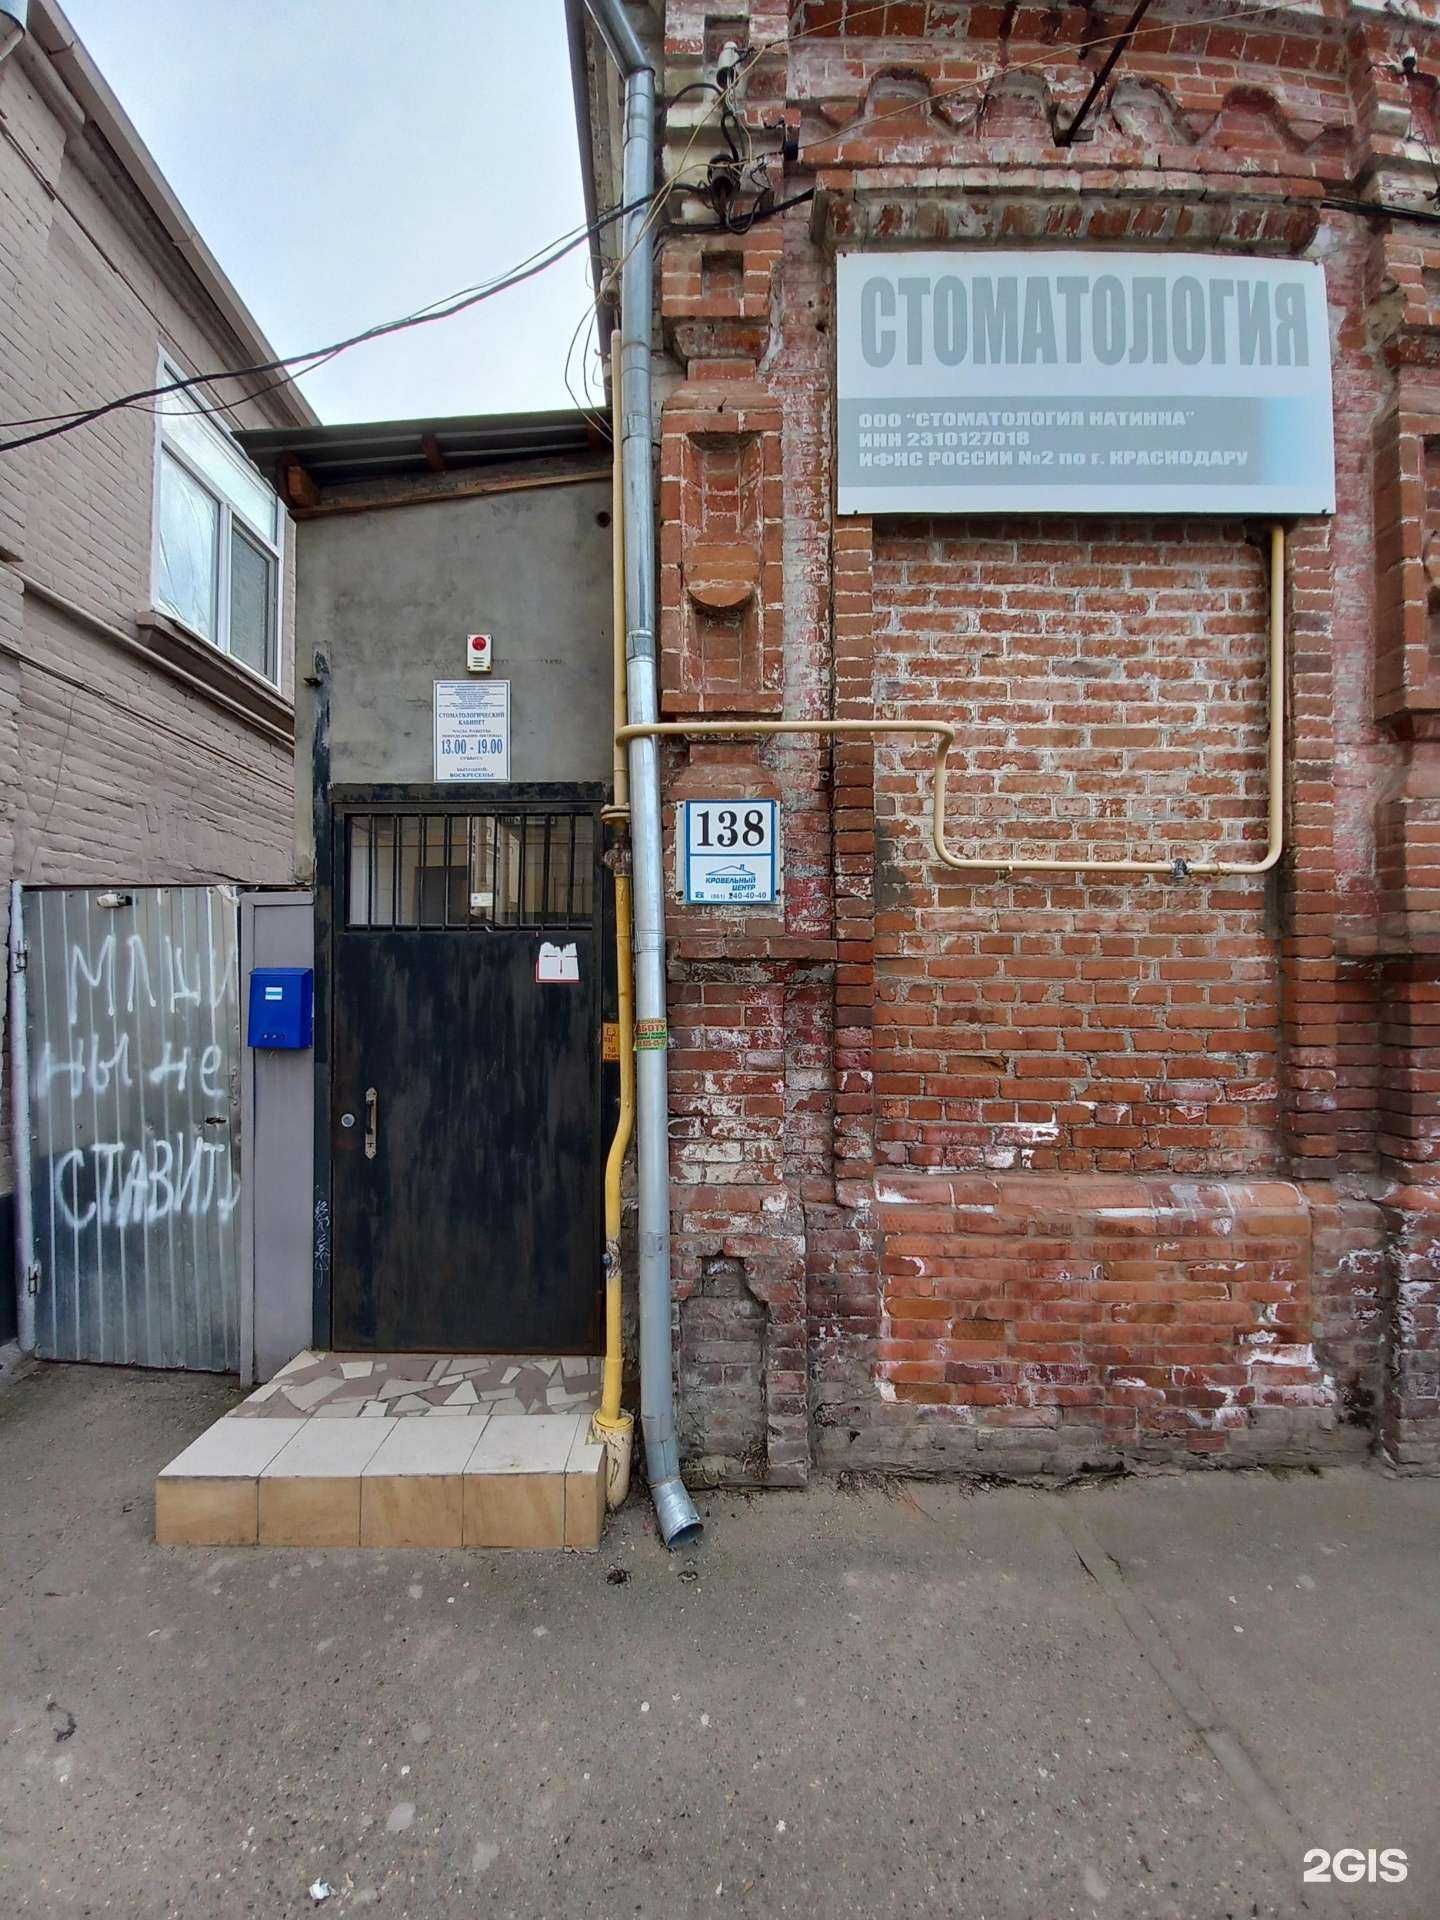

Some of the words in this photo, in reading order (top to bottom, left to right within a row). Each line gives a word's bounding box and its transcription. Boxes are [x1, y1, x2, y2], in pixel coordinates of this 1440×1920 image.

[860, 275, 1310, 368] СТОМАТОЛОГИЯ
[858, 412, 902, 428] ООО
[858, 431, 902, 448] ИНН
[906, 431, 1030, 448] 2310127018
[858, 451, 923, 467] ИФНС
[928, 451, 1014, 467] РОССИИ
[1018, 450, 1055, 466] №2
[1058, 452, 1087, 466] по
[1109, 449, 1249, 468] КРАСНОДАРУ
[441, 738, 467, 755] 13.00
[477, 738, 503, 754] 19.00
[696, 809, 765, 848] 138
[705, 876, 756, 884] КРОВЕЛЬНЫЙ
[732, 884, 756, 892] ЦЕНТР
